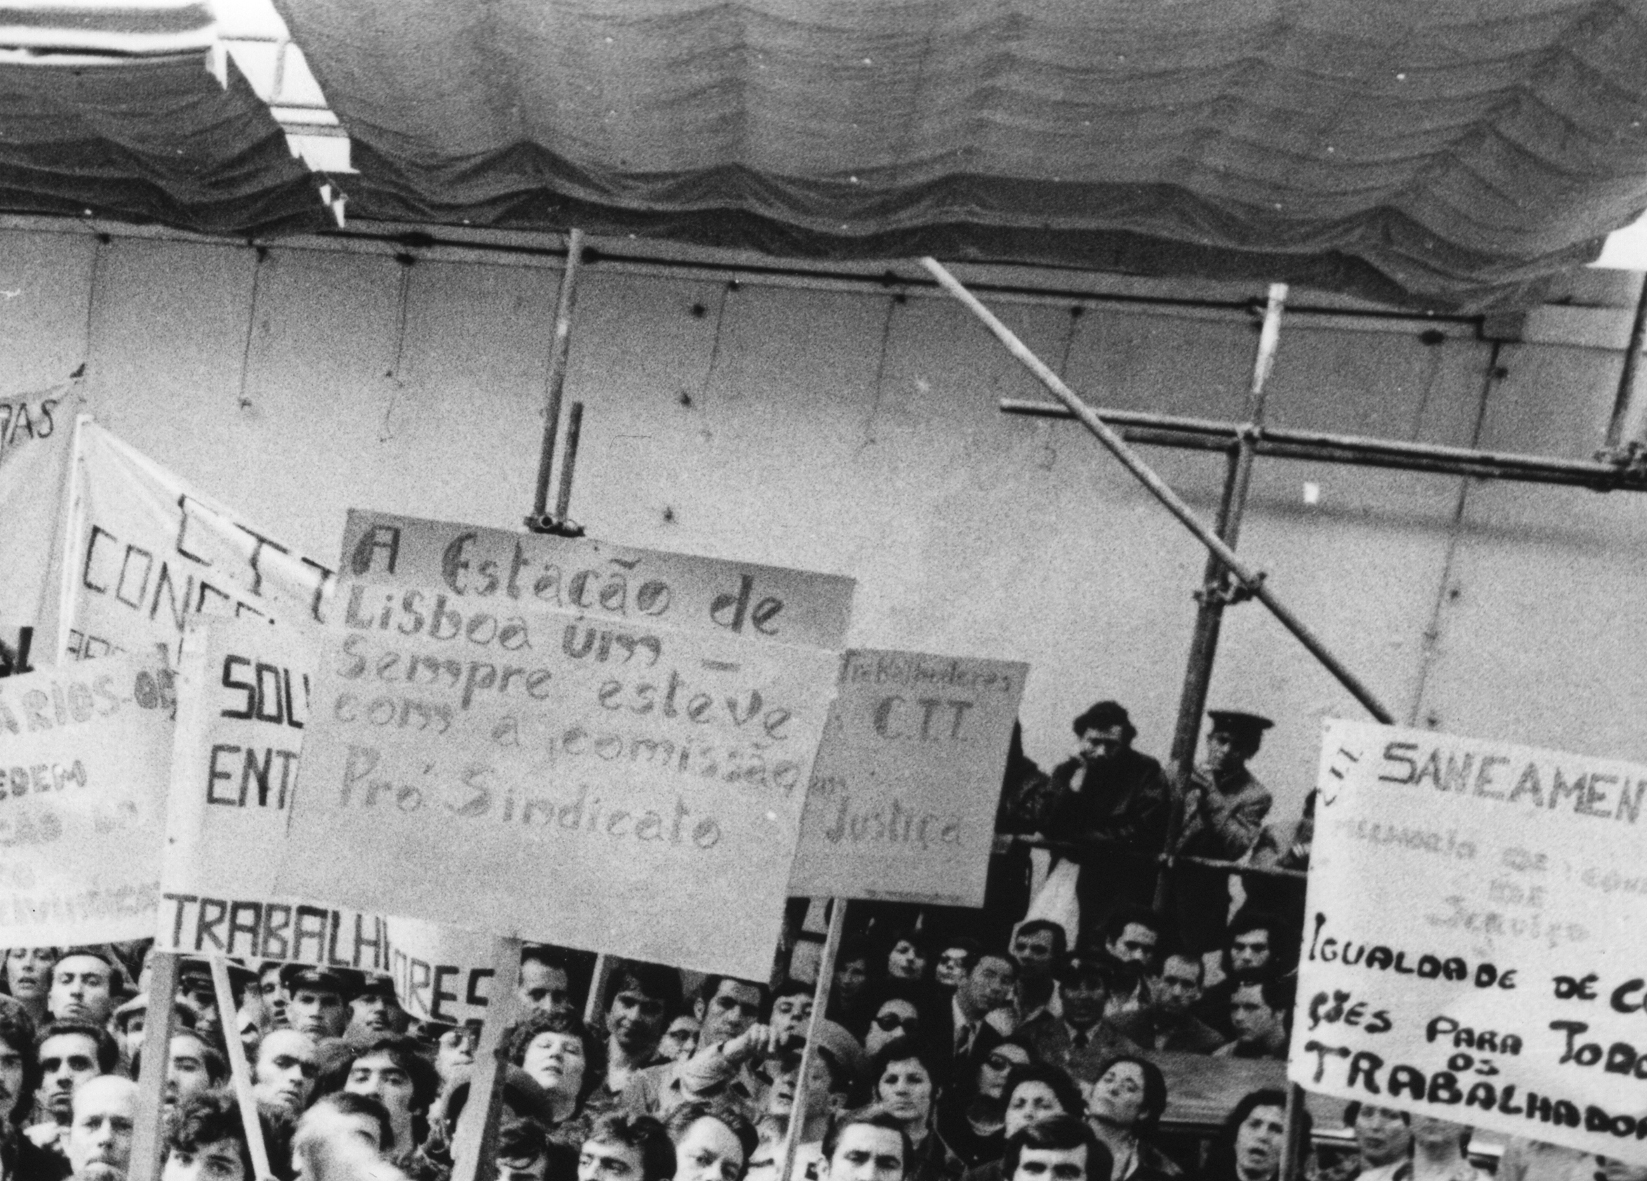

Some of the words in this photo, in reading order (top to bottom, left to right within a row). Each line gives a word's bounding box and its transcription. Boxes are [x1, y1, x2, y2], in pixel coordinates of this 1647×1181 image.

[352, 525, 401, 577] A
[709, 573, 784, 636] de
[346, 585, 533, 651] Lisboa
[335, 694, 452, 735] com
[491, 716, 521, 747] a
[599, 670, 792, 741] esteve
[1308, 911, 1518, 990] IGUALDADE
[1553, 973, 1599, 1001] DE
[1609, 978, 1647, 1014] C
[1426, 1015, 1523, 1056] PARA
[1447, 1052, 1501, 1077] OS
